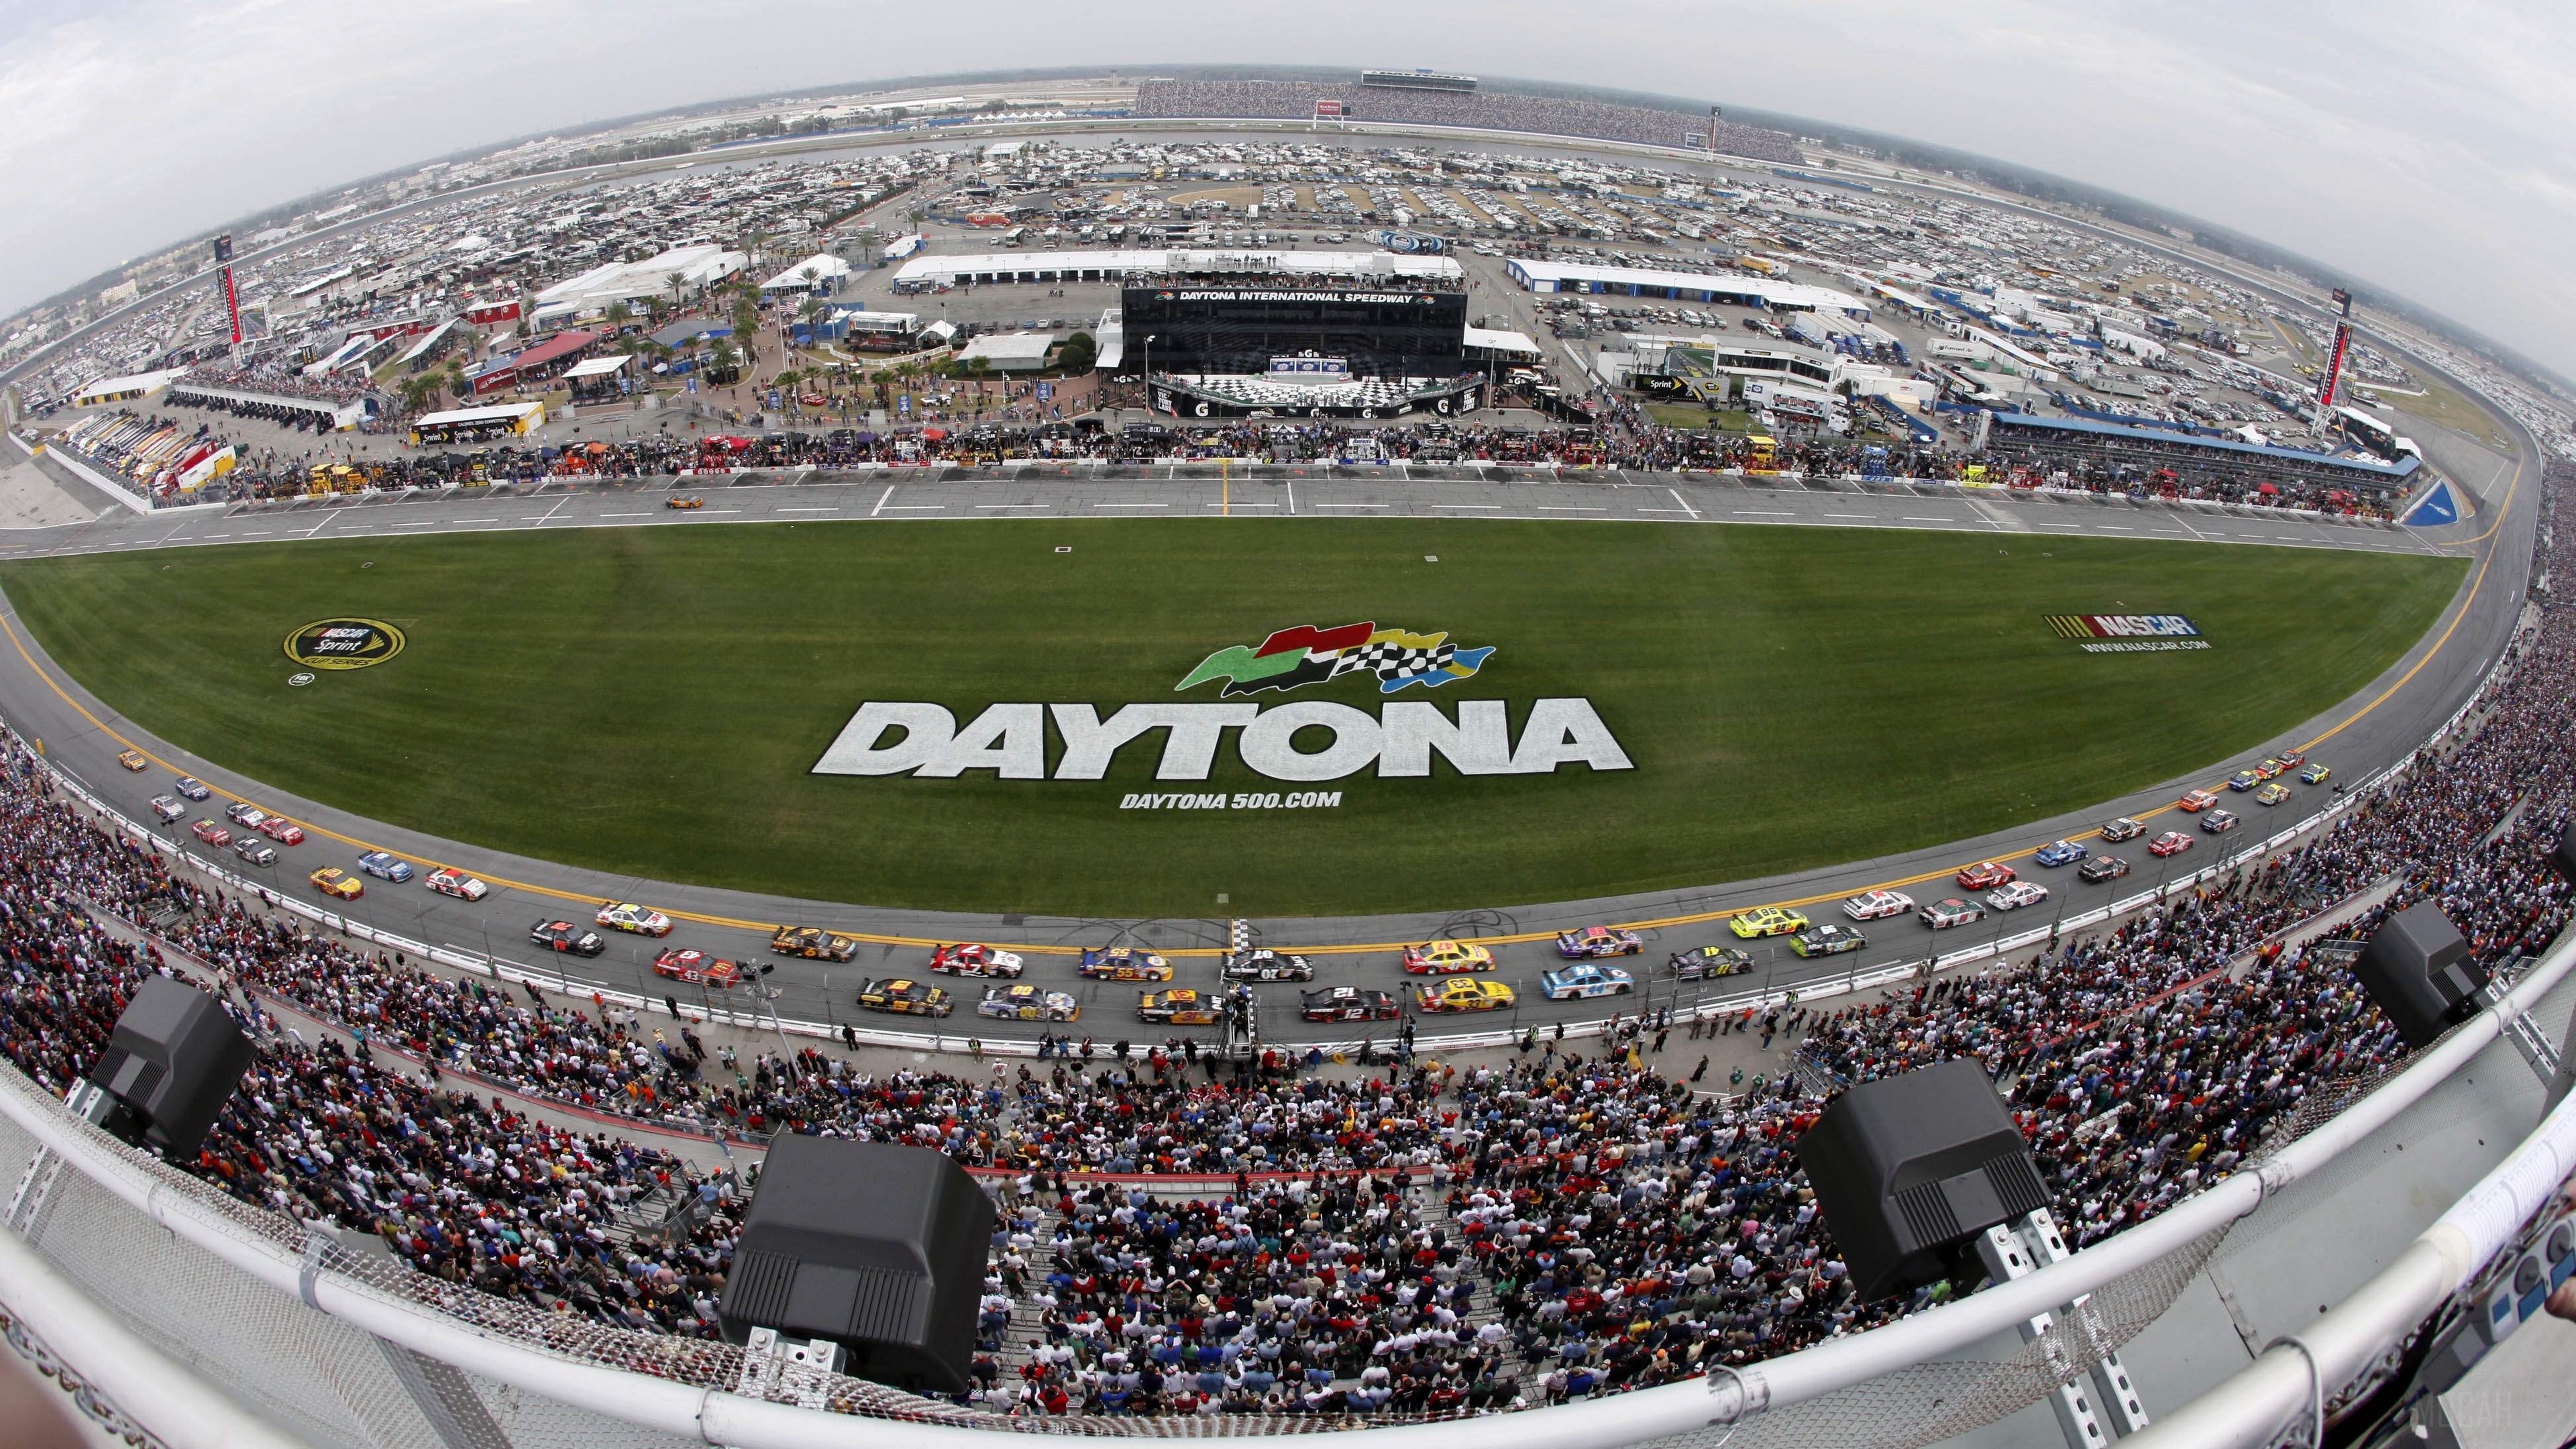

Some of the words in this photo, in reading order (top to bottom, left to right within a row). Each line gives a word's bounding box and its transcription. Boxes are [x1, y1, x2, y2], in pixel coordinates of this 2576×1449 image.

[1179, 291, 1236, 301] DAYTONA
[1238, 292, 1341, 302] INTERNATIONAL
[1344, 294, 1413, 304] SPEEDWAY
[1650, 380, 1672, 389] Sprint
[1157, 391, 1167, 399] VIC
[1195, 403, 1208, 417] G
[424, 433, 442, 442] Sprint
[2094, 616, 2197, 636] NASCAR
[321, 628, 370, 638] NASCAR
[314, 639, 362, 653] Sprint
[2080, 641, 2212, 653] WWW.NASCAR.COM
[810, 698, 1635, 782] DAYTONA
[1120, 793, 1227, 810] DAYTONA
[1230, 792, 1342, 810] 500.COM
[684, 970, 699, 981] 43
[1116, 967, 1134, 977] 55
[1260, 969, 1279, 979] 07
[1019, 1006, 1036, 1018] 00
[1344, 1008, 1364, 1019] 12
